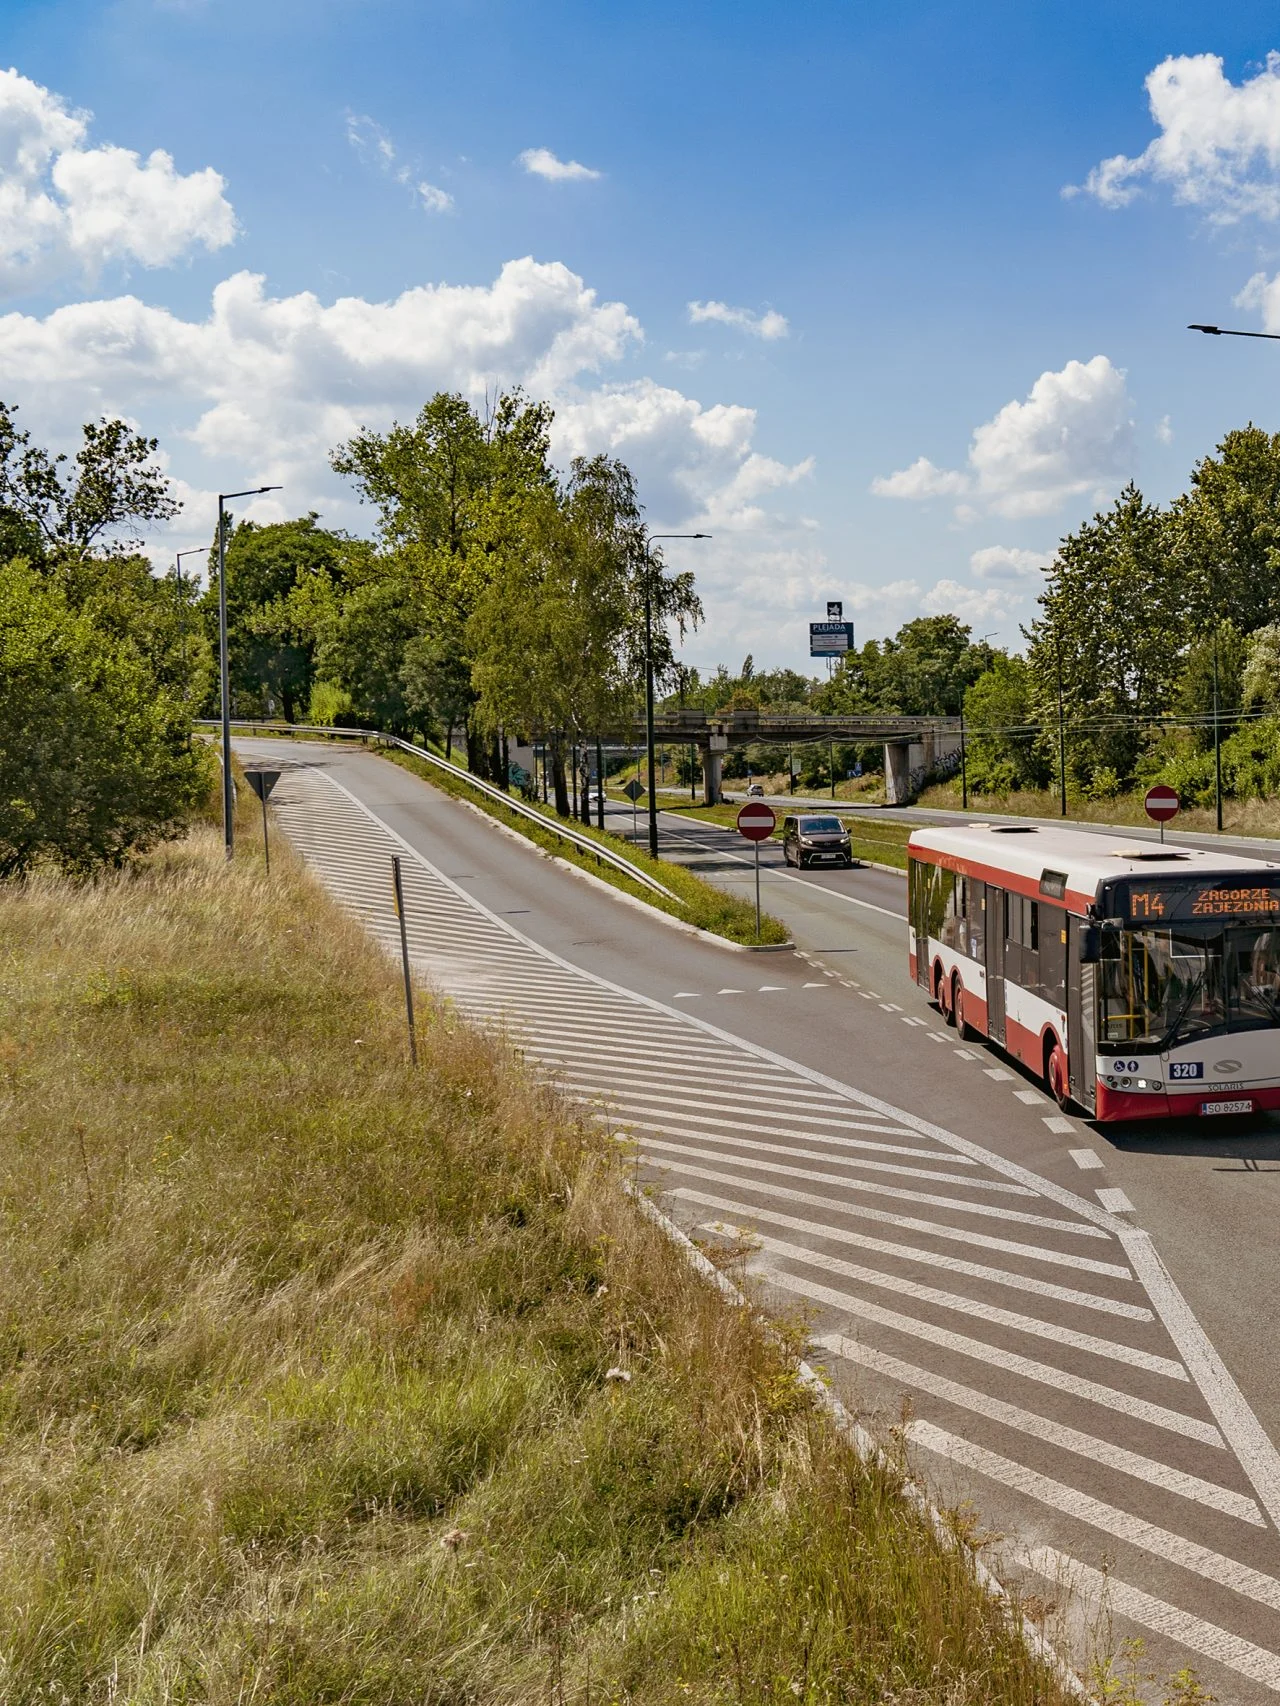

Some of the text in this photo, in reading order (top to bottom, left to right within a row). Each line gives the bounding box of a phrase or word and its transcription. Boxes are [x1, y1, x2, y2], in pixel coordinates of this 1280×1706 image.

[1132, 893, 1164, 916] M4
[1192, 901, 1279, 913] ZAJEZDNIA
[1174, 1064, 1197, 1077] 320
[1207, 1082, 1244, 1092] SOLARIS
[1208, 1103, 1220, 1113] SO
